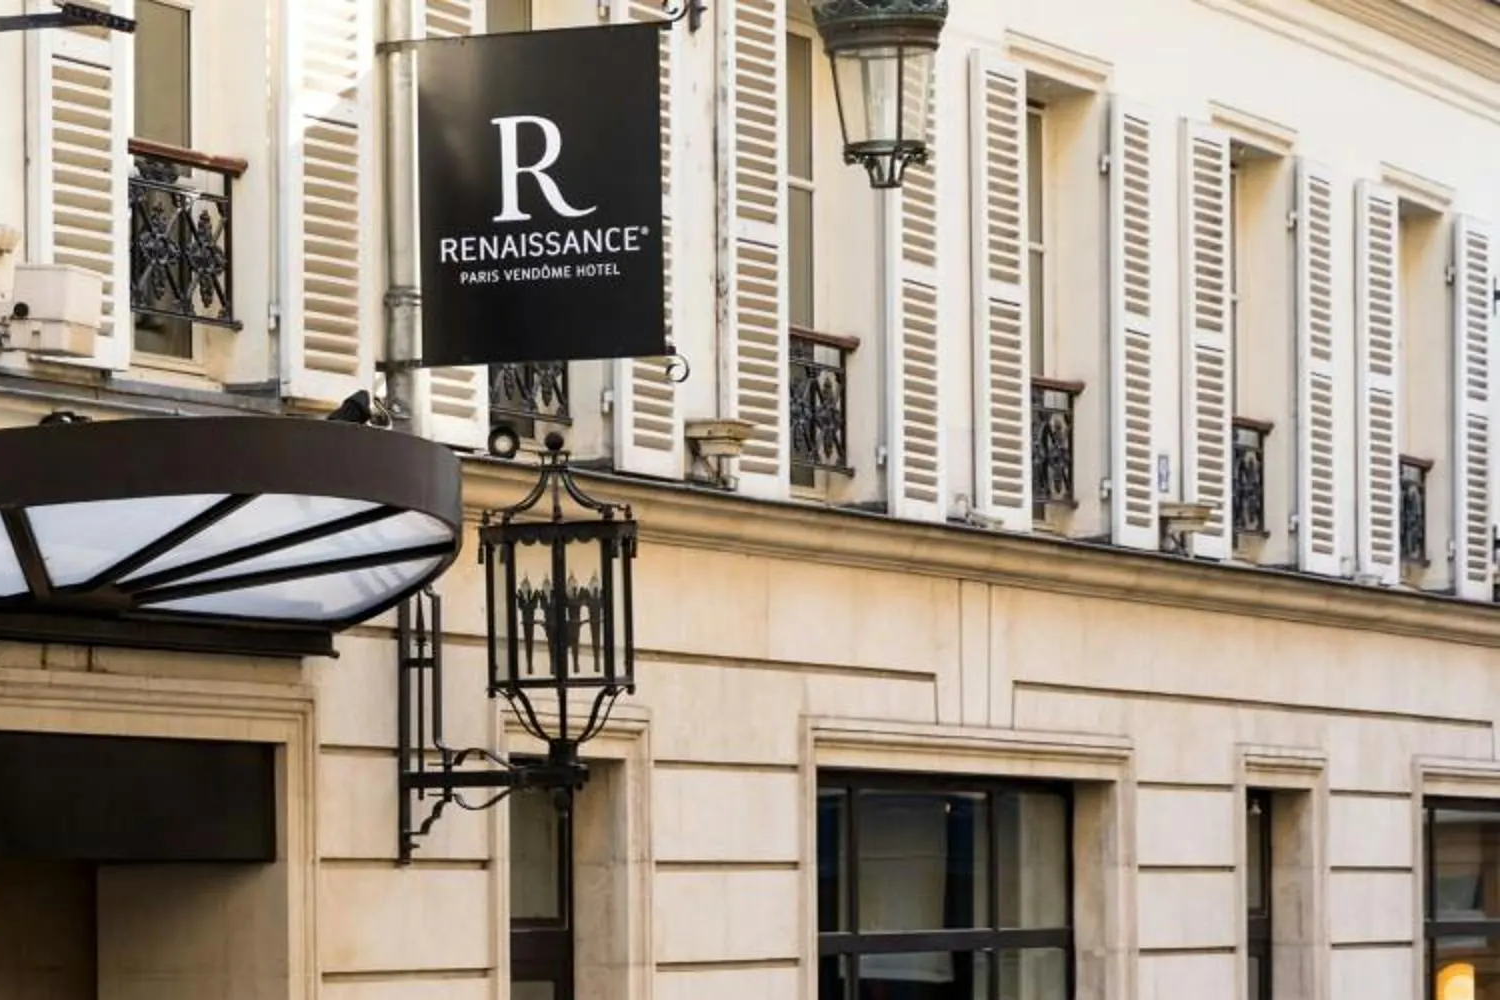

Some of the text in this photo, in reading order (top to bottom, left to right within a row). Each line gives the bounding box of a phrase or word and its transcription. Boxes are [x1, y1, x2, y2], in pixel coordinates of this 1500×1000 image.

[490, 115, 597, 222] R
[459, 263, 621, 285] PARIS VENDÔME HOTEL
